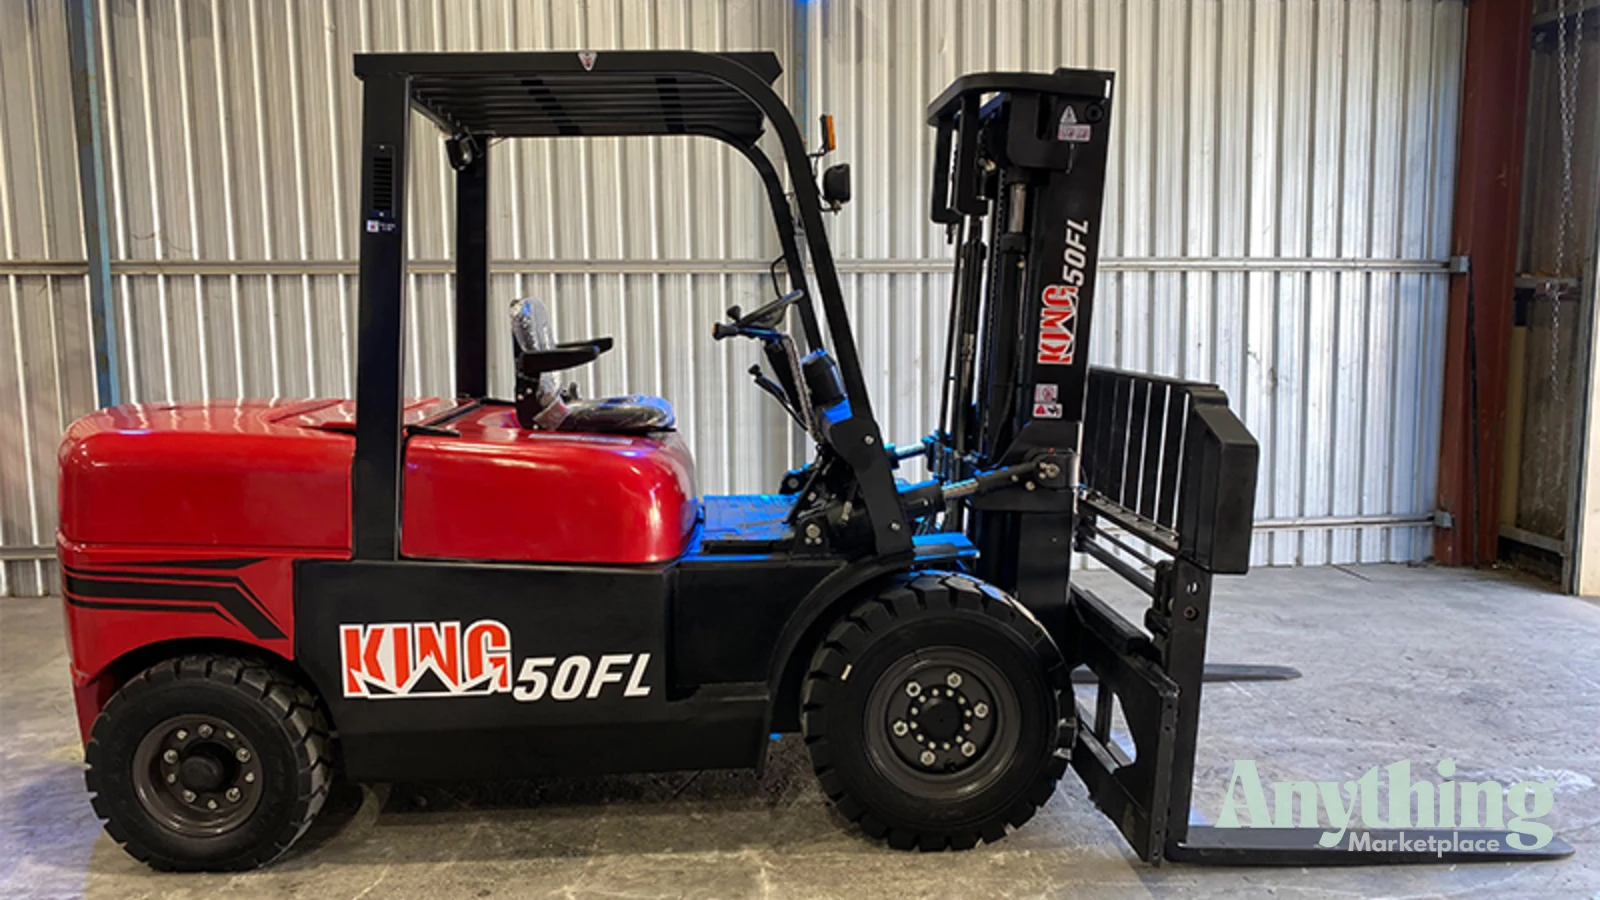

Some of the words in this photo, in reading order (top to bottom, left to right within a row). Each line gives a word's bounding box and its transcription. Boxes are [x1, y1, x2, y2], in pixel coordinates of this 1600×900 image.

[1037, 285, 1079, 364] KING
[1063, 219, 1088, 287] 50FL
[340, 620, 512, 698] KING
[513, 653, 651, 701] 50FL
